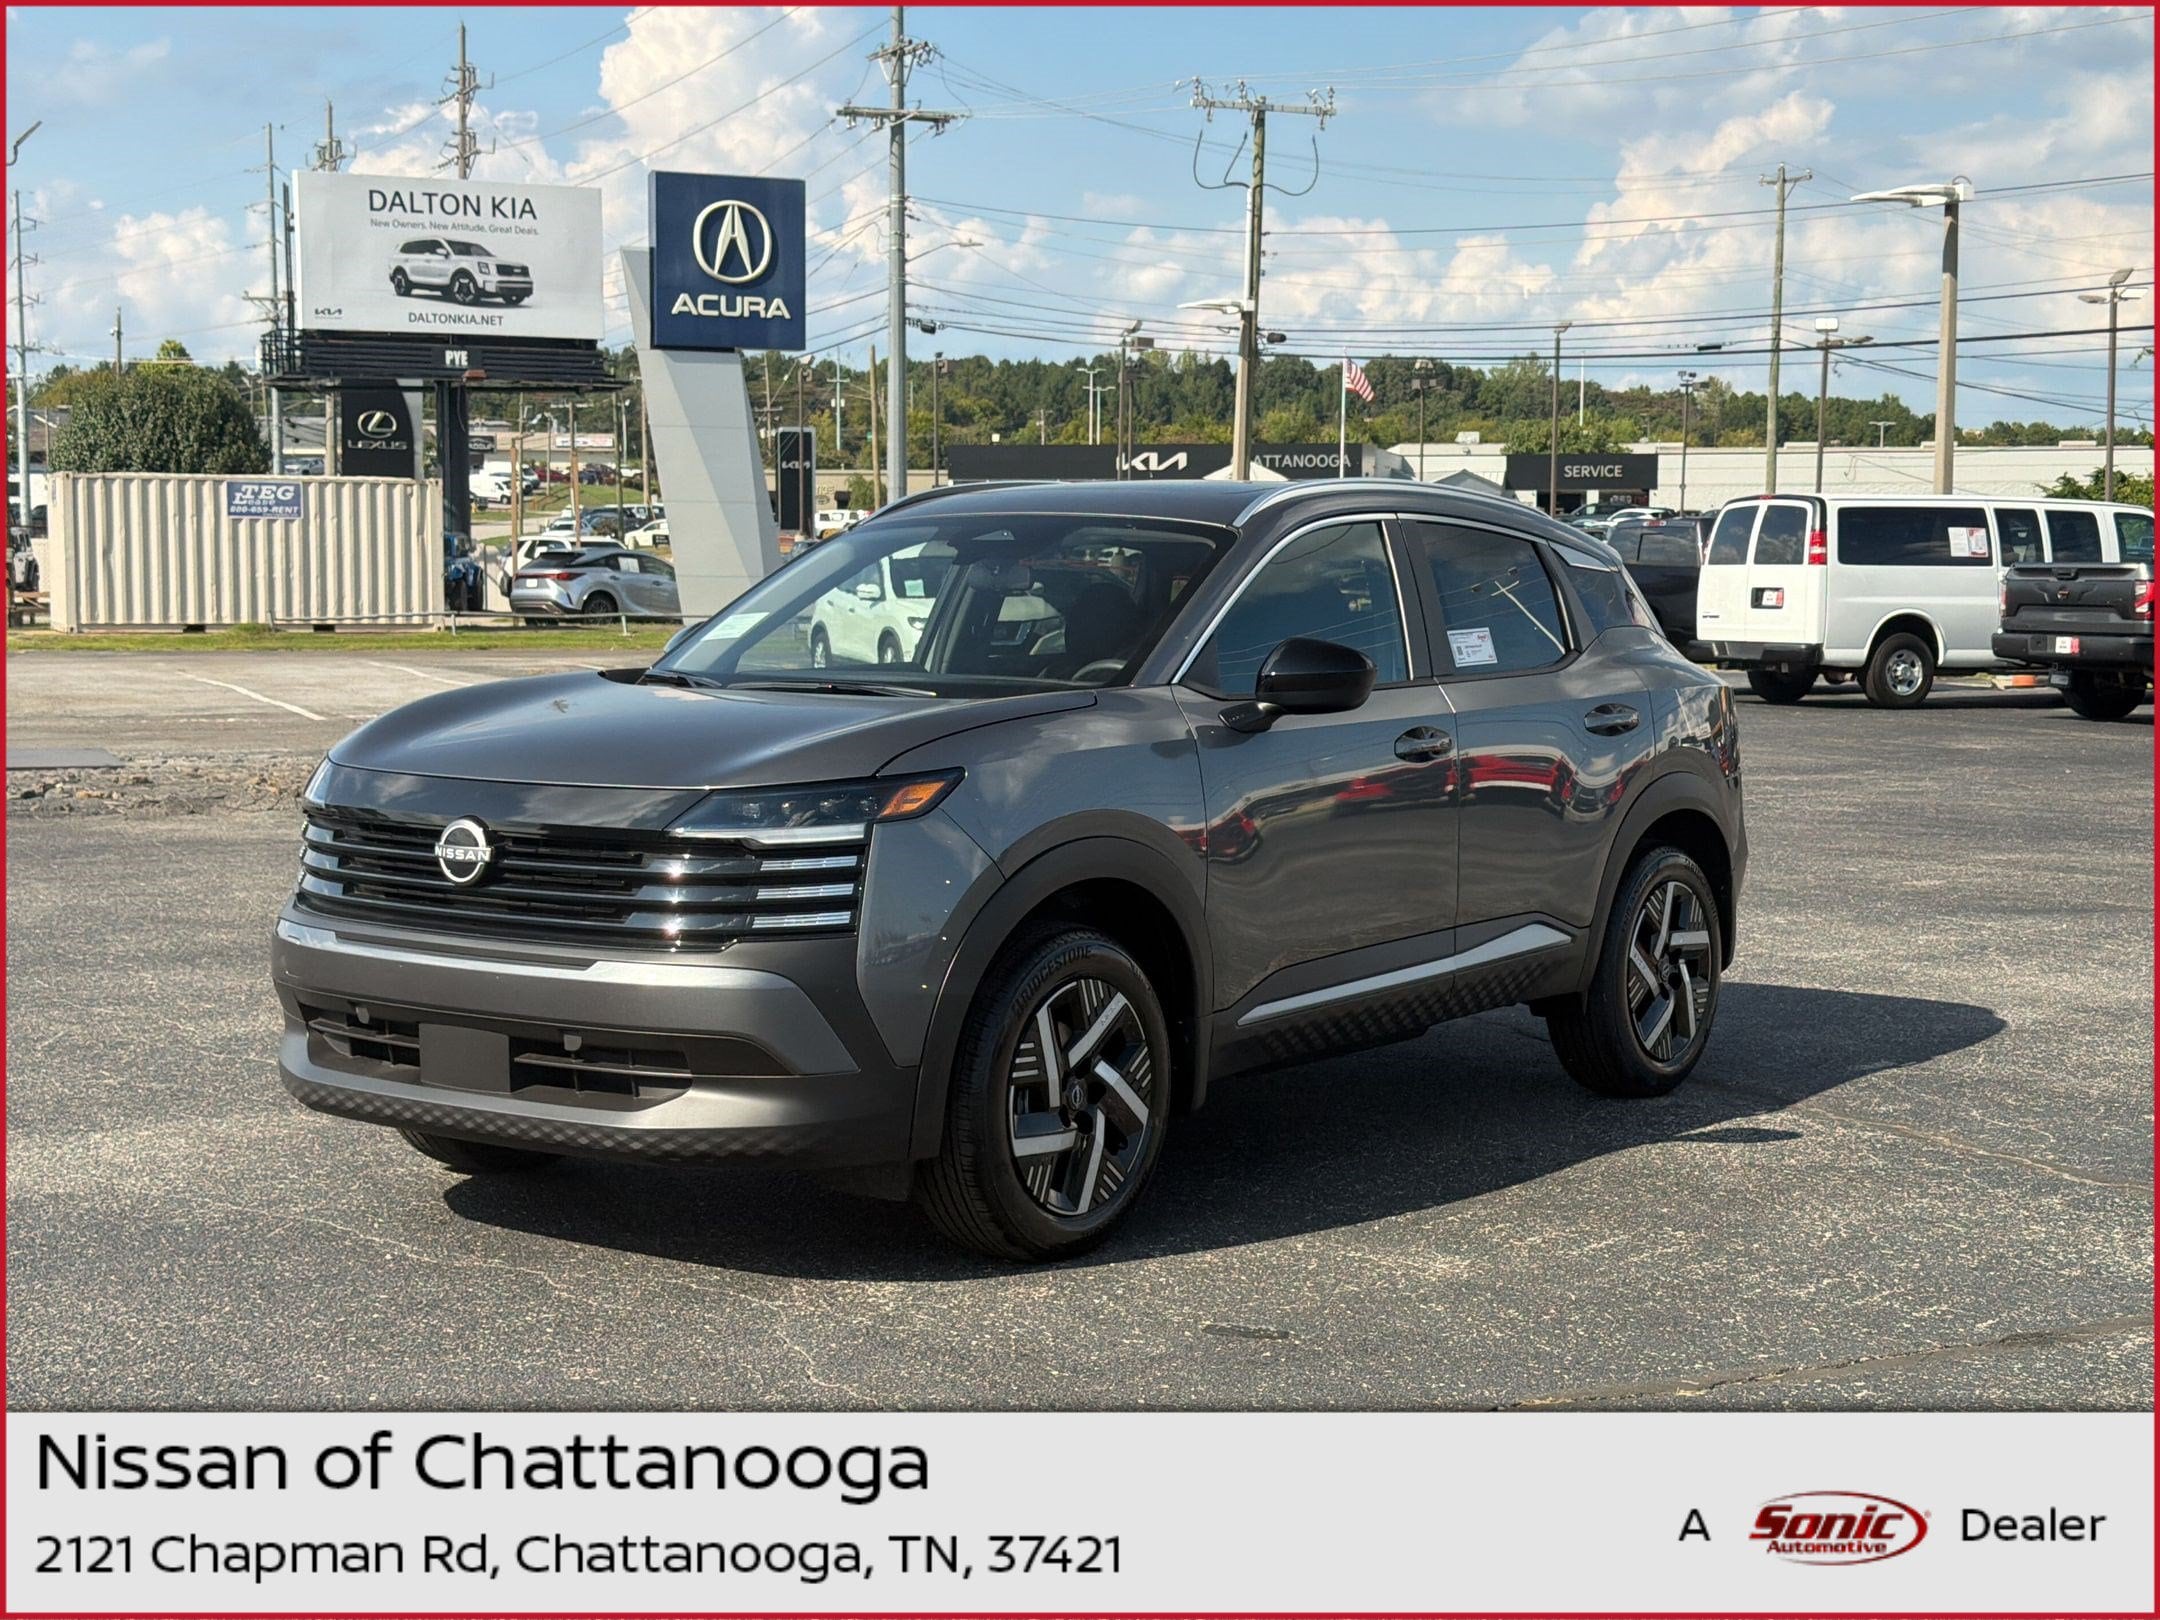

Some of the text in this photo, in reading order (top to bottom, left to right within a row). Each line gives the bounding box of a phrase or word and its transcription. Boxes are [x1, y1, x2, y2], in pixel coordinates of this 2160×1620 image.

[369, 190, 538, 220] DALTON KIA
[370, 218, 539, 236] New Owners. New Attitude. Great Deals.
[671, 293, 791, 319] ACURA
[408, 312, 505, 327] DALTONKIA.NET
[445, 350, 468, 367] PYE
[347, 440, 407, 450] LEXUS
[1231, 455, 1350, 468] ATTANOOGA
[1564, 465, 1623, 478] SERVICE
[241, 485, 295, 501] TEG
[434, 844, 491, 862] NISSAN
